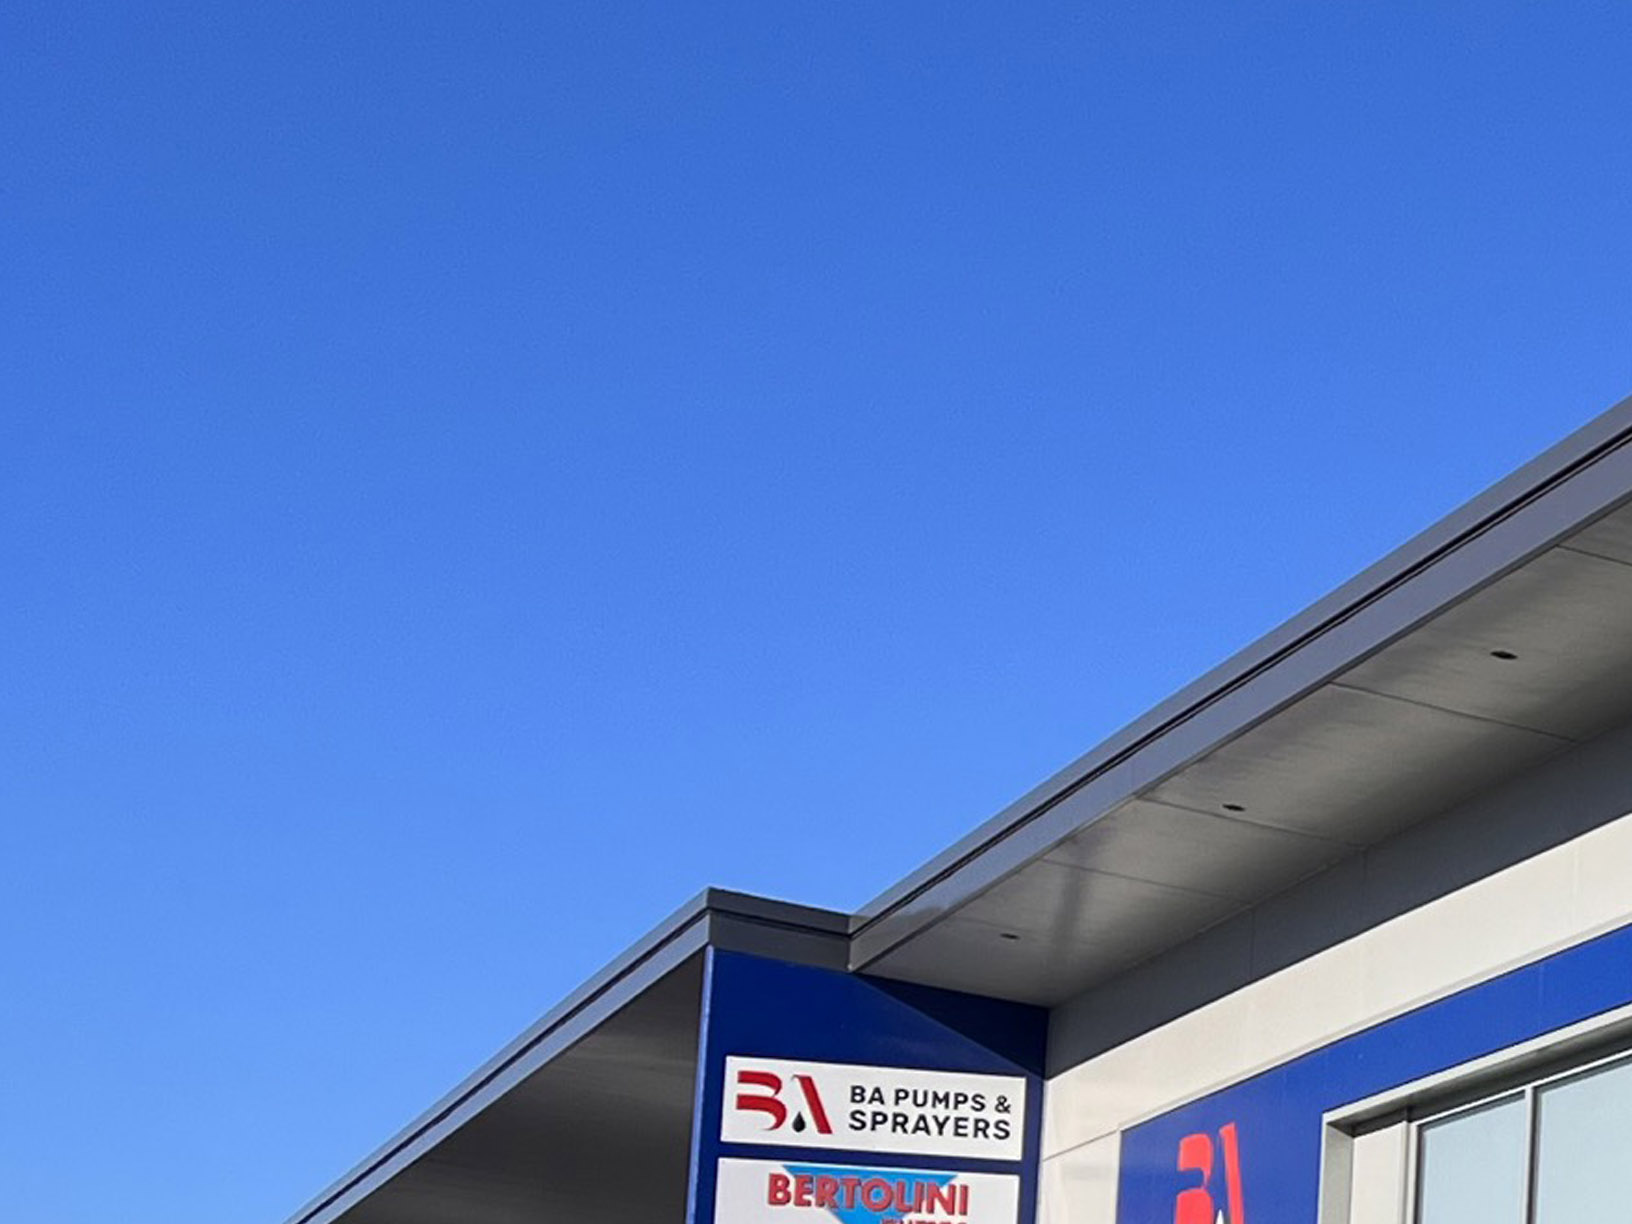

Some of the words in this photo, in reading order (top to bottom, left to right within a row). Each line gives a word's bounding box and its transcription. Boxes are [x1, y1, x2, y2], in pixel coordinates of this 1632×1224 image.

[736, 1070, 833, 1134] BA
[850, 1085, 885, 1105] BA
[894, 1088, 986, 1112] PUMPS
[994, 1095, 1011, 1114] &
[849, 1109, 1011, 1140] SPRAYERS
[768, 1173, 970, 1216] BERTOLINI
